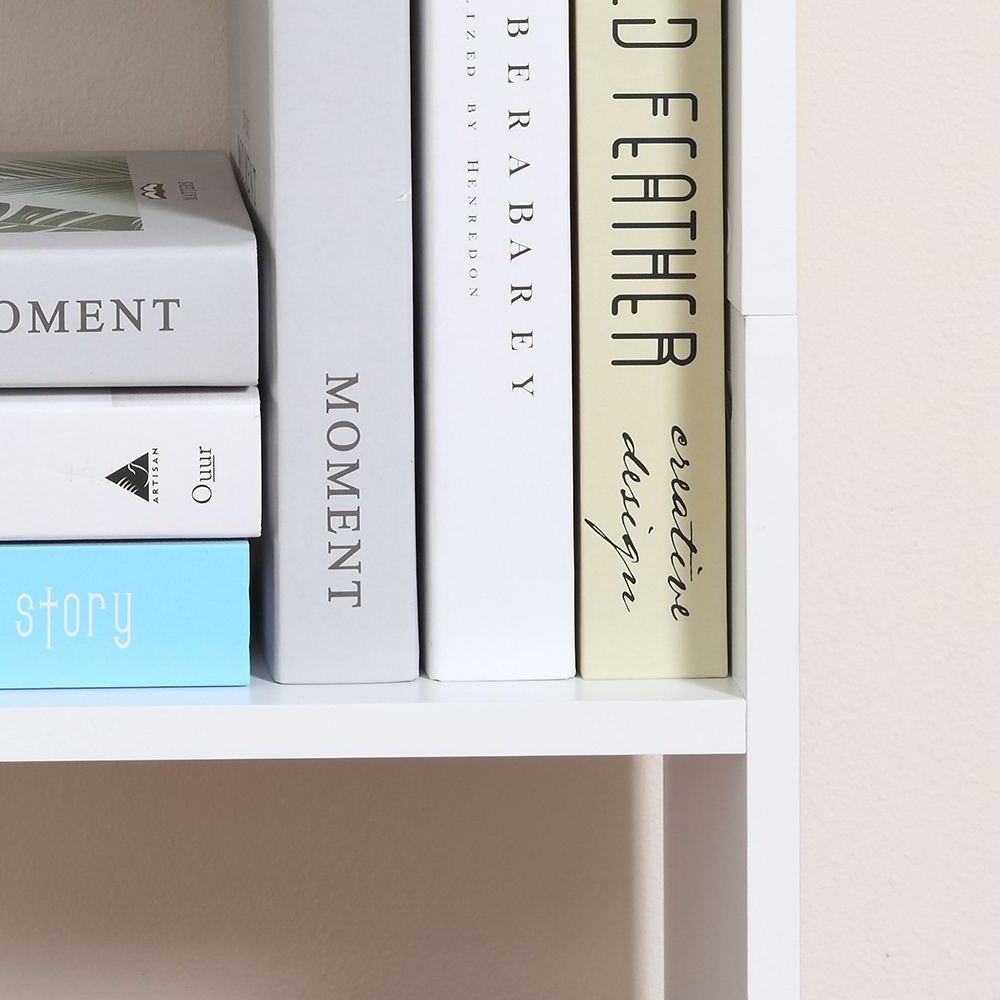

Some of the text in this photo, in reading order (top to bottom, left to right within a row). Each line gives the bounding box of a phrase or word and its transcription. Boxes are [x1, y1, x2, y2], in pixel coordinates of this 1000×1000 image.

[466, 103, 477, 131] BY
[466, 159, 480, 298] HENREDON
[610, 92, 699, 367] FEATHER
[151, 447, 160, 504] ARTISAN
[325, 372, 362, 608] MOMENT
[584, 431, 654, 613] design
[667, 425, 703, 621] creative
[15, 586, 133, 650] story
